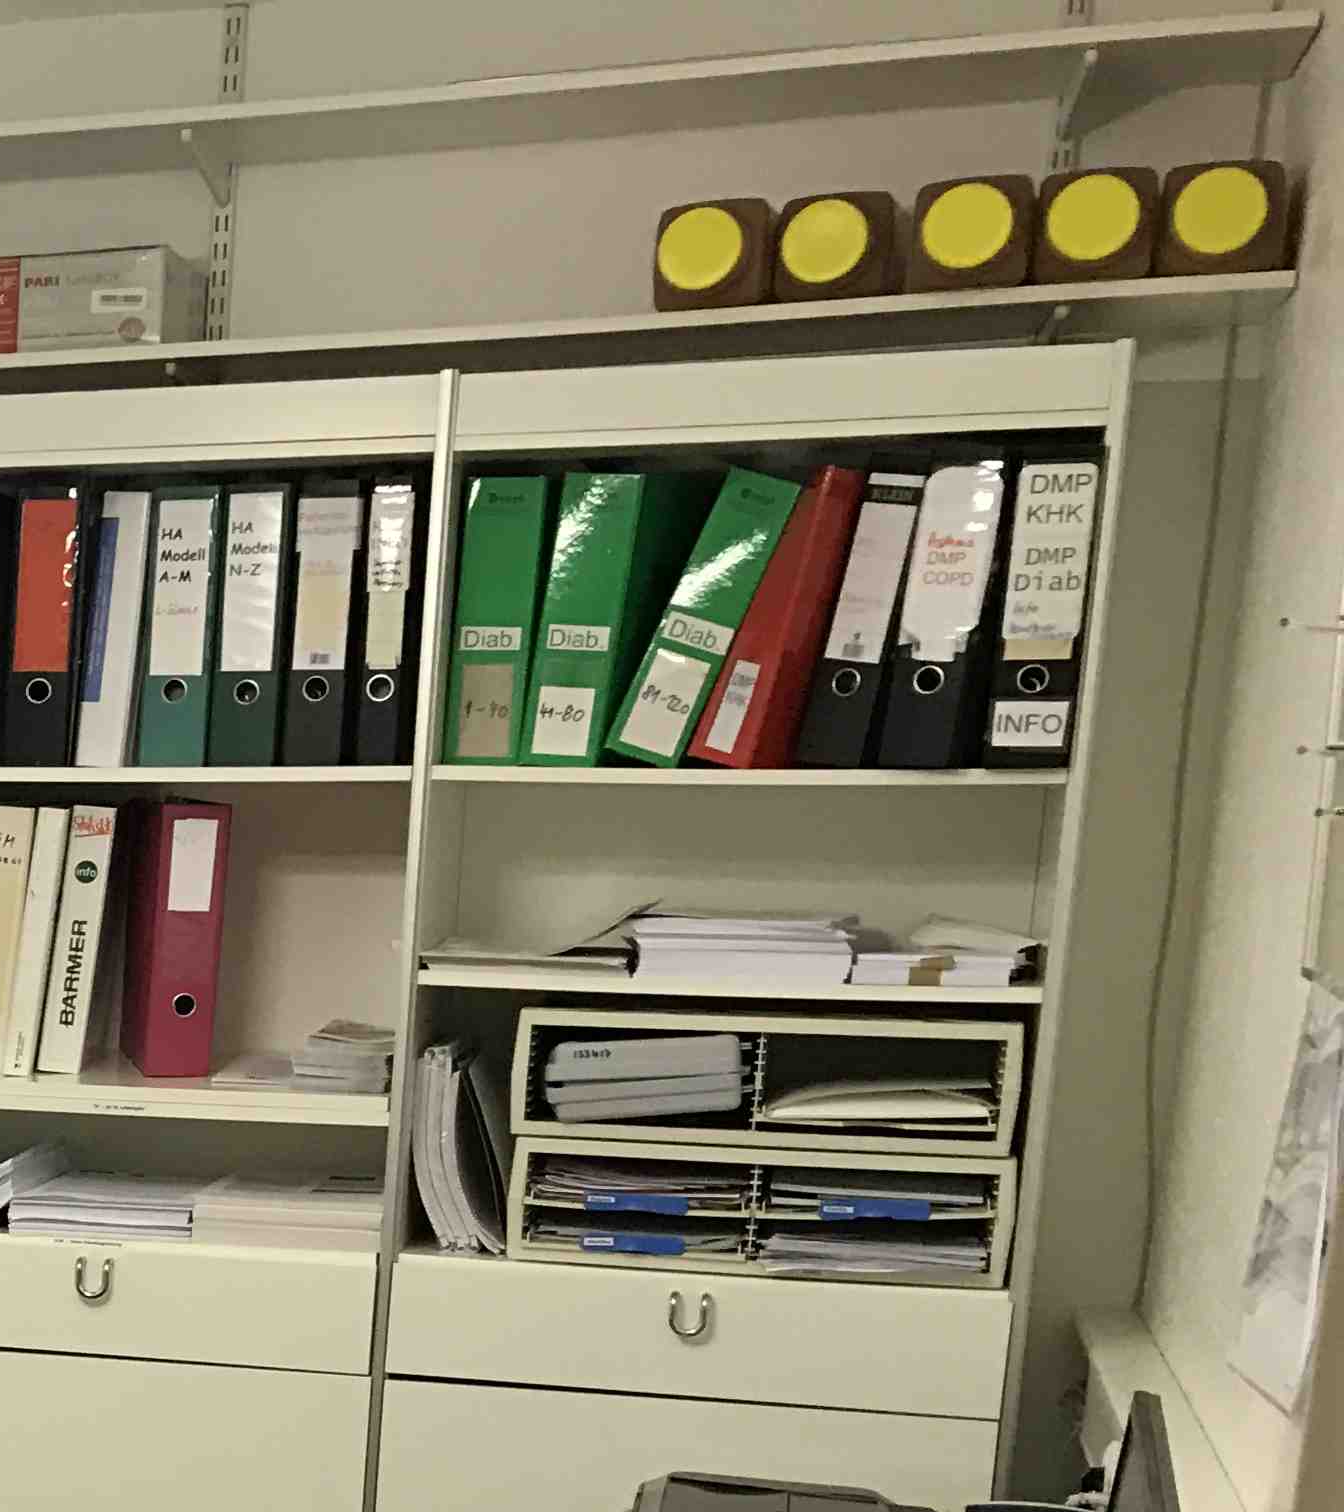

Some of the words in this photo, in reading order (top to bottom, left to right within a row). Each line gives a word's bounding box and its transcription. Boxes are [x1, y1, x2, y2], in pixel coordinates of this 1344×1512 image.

[25, 275, 60, 289] PARI
[1030, 473, 1093, 495] DMP
[1026, 504, 1084, 524] KHK
[161, 528, 183, 540] HA
[232, 521, 253, 534] HA
[160, 547, 206, 562] Modell
[1024, 547, 1077, 566] DMP
[159, 570, 192, 583] A-M
[229, 562, 261, 576] N-Z
[923, 571, 974, 586] COPD
[1014, 570, 1081, 591] Diab
[996, 714, 1062, 734] INFO
[59, 919, 88, 1027] BARMER
